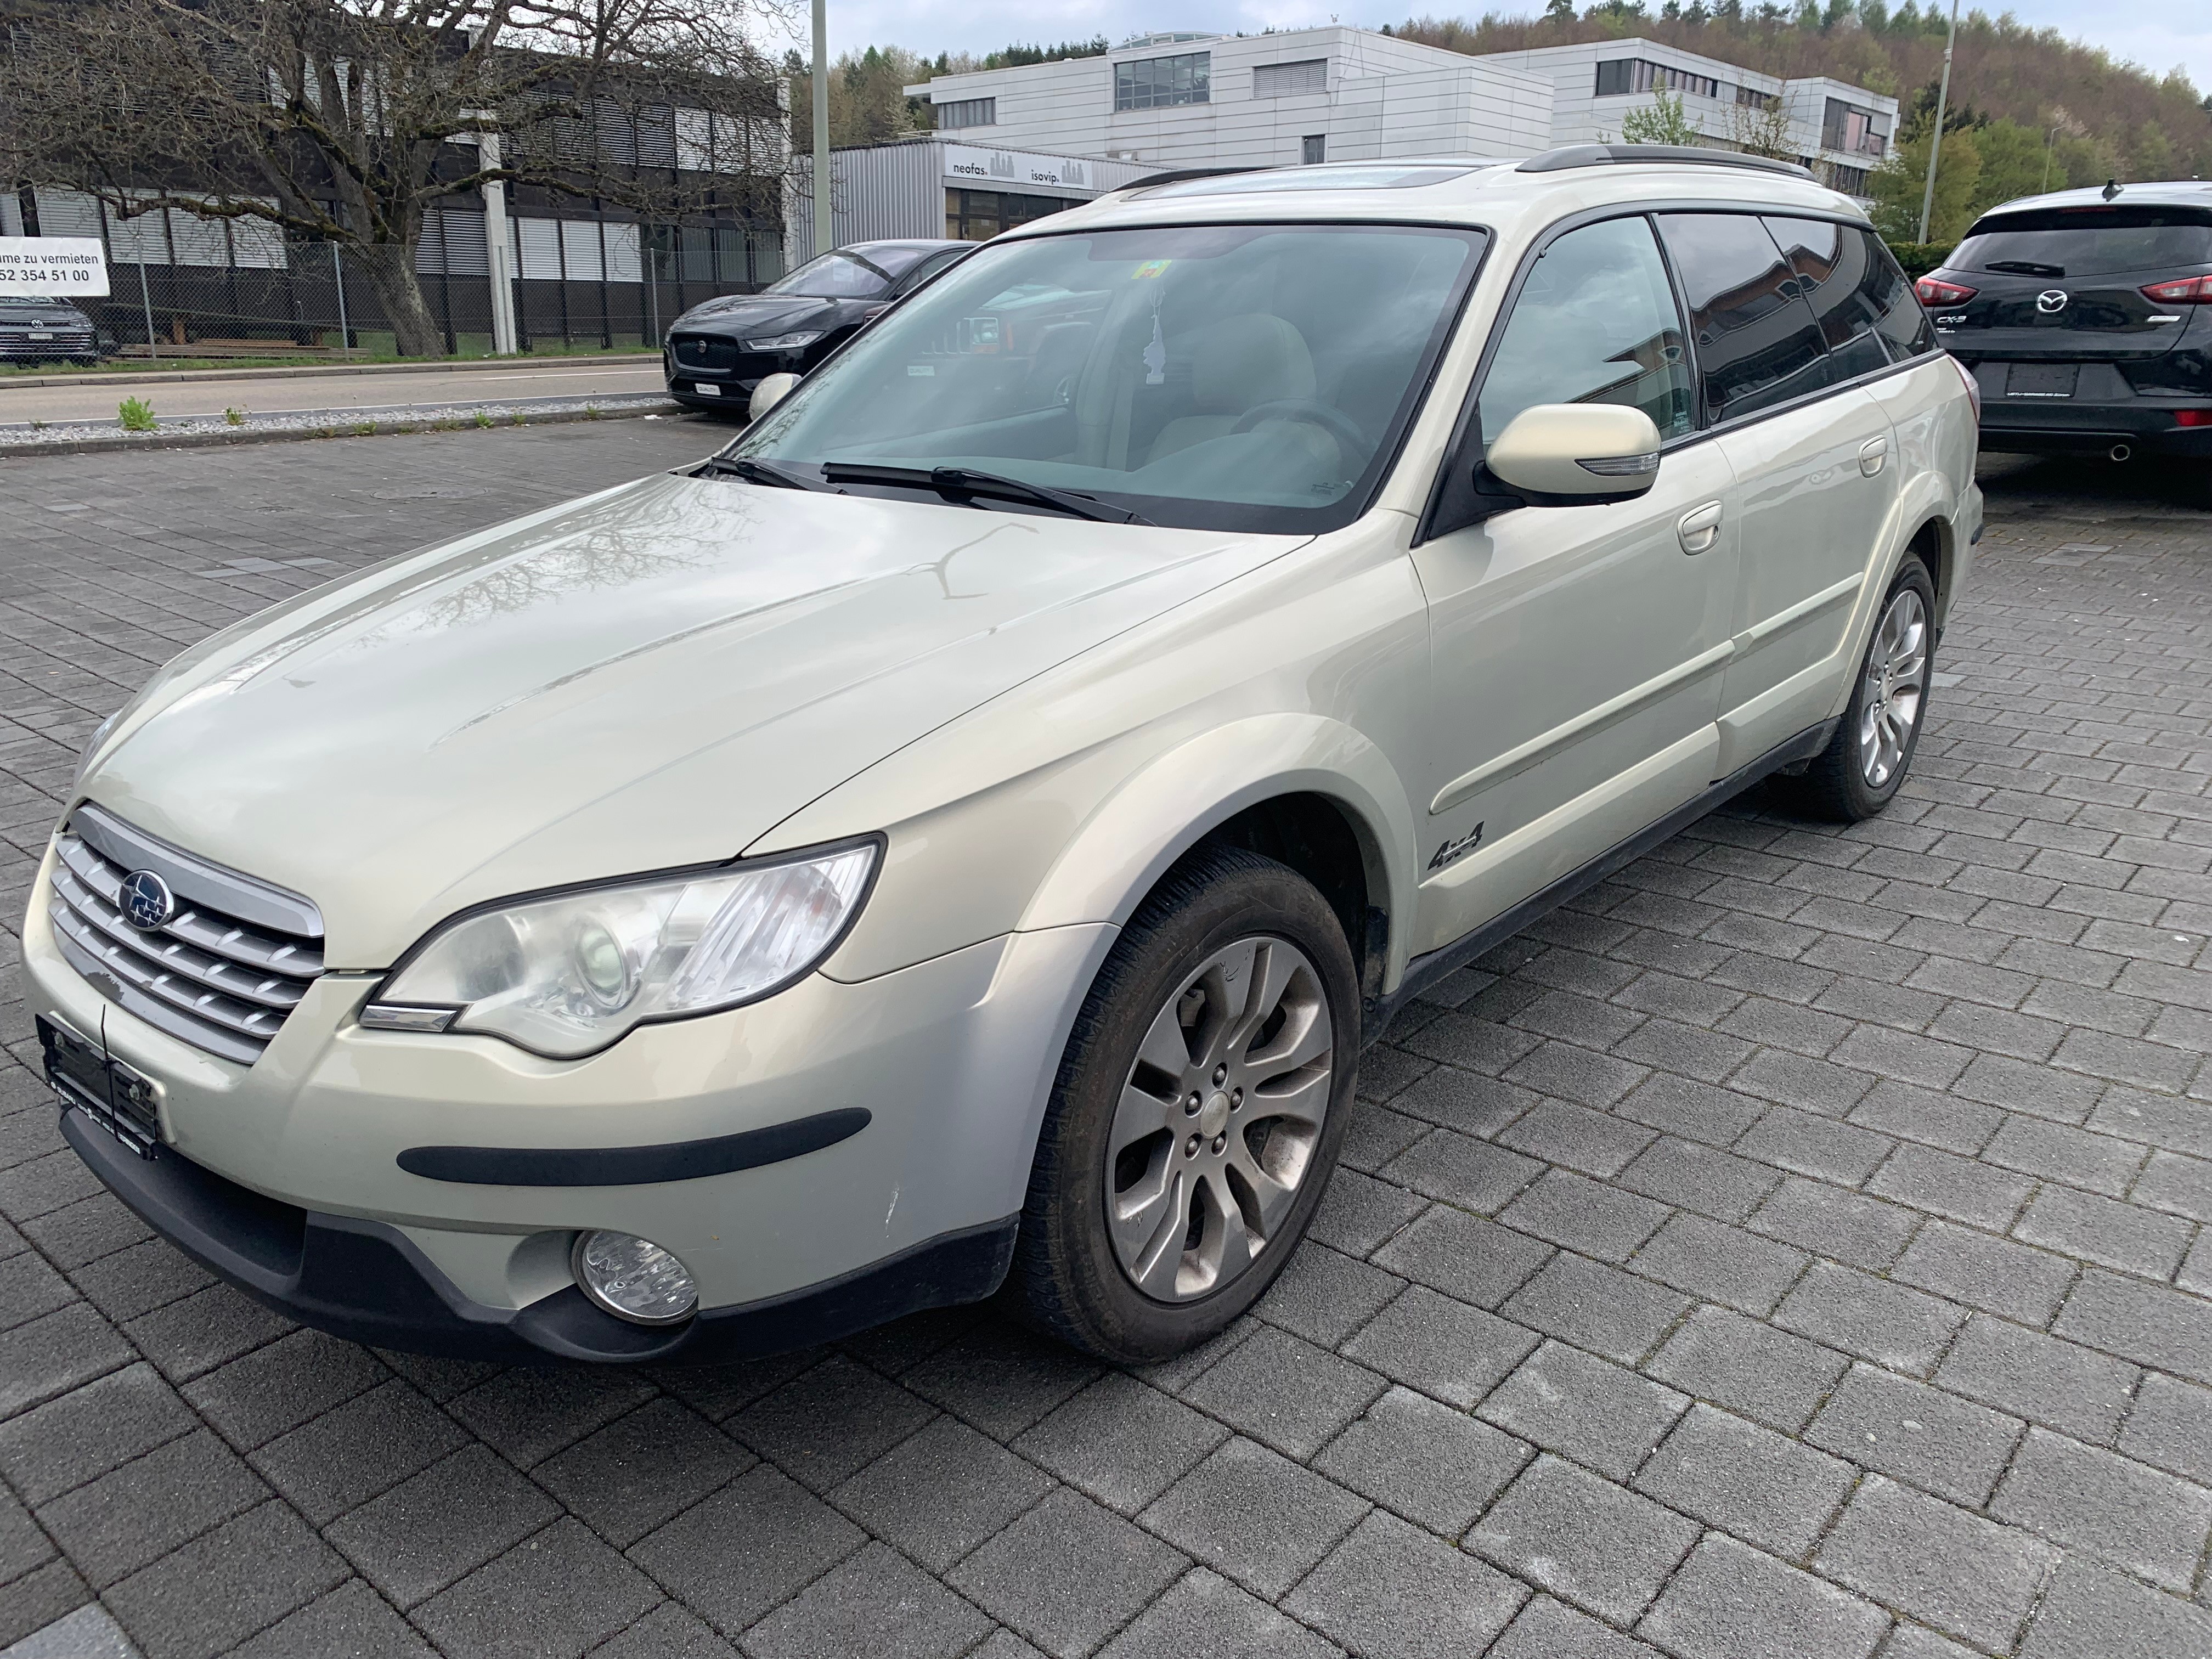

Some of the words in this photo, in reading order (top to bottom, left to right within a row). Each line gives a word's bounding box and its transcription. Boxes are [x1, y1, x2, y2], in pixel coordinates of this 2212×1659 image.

[24, 255, 37, 263] zu
[41, 253, 98, 264] vermieten
[20, 269, 47, 281] 354
[52, 270, 66, 281] 51
[72, 270, 89, 281] 00
[1937, 315, 1967, 323] CX-3
